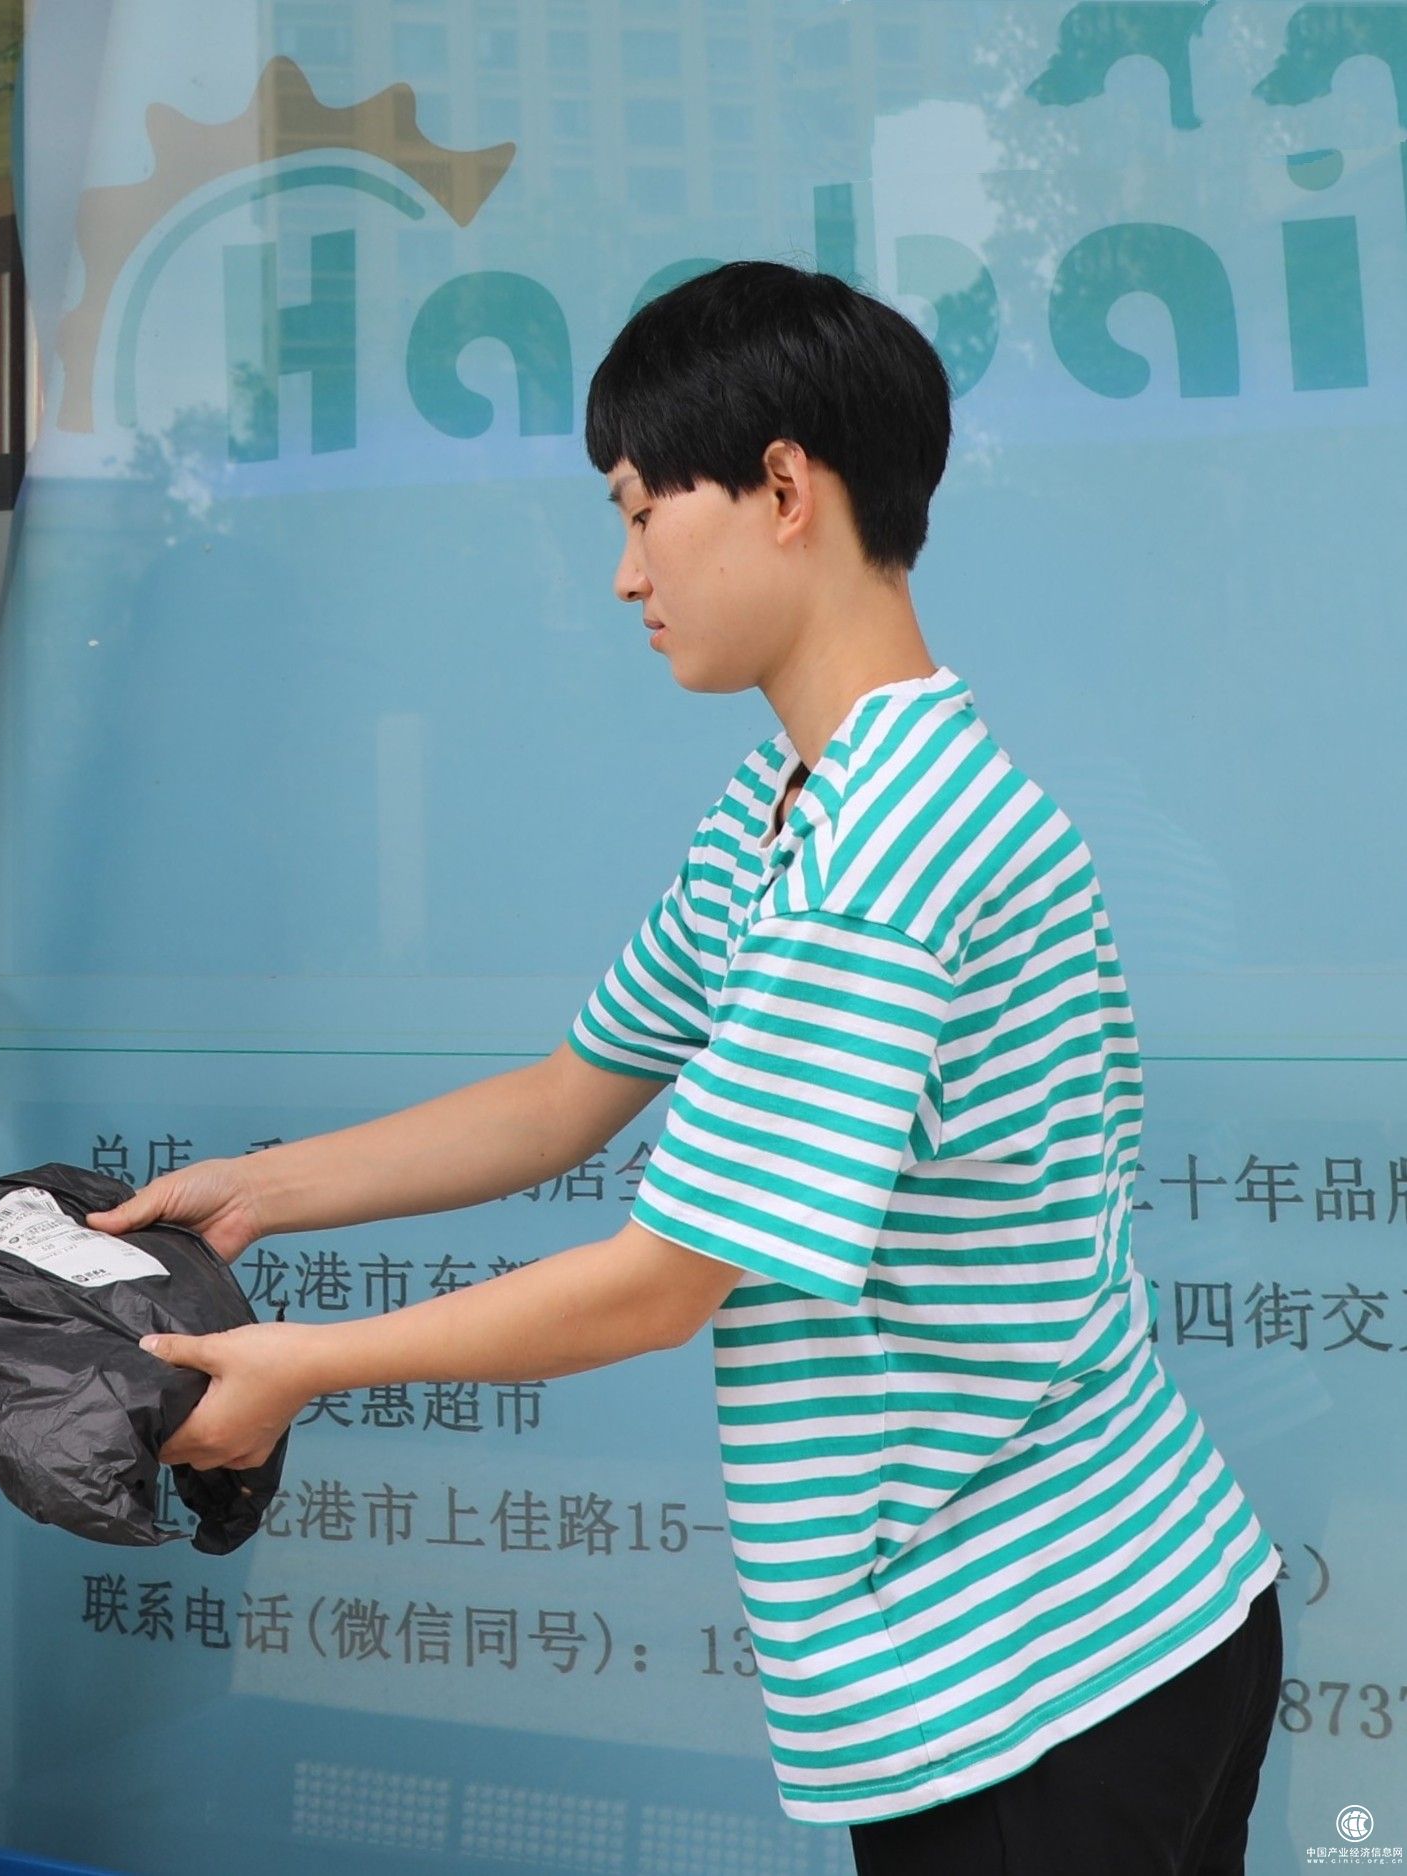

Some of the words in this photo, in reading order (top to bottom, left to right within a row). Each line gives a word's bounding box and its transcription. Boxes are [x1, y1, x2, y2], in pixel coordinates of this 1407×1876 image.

[1150, 1280, 1407, 1352] 四街交
[1278, 1678, 1407, 1740] 873
